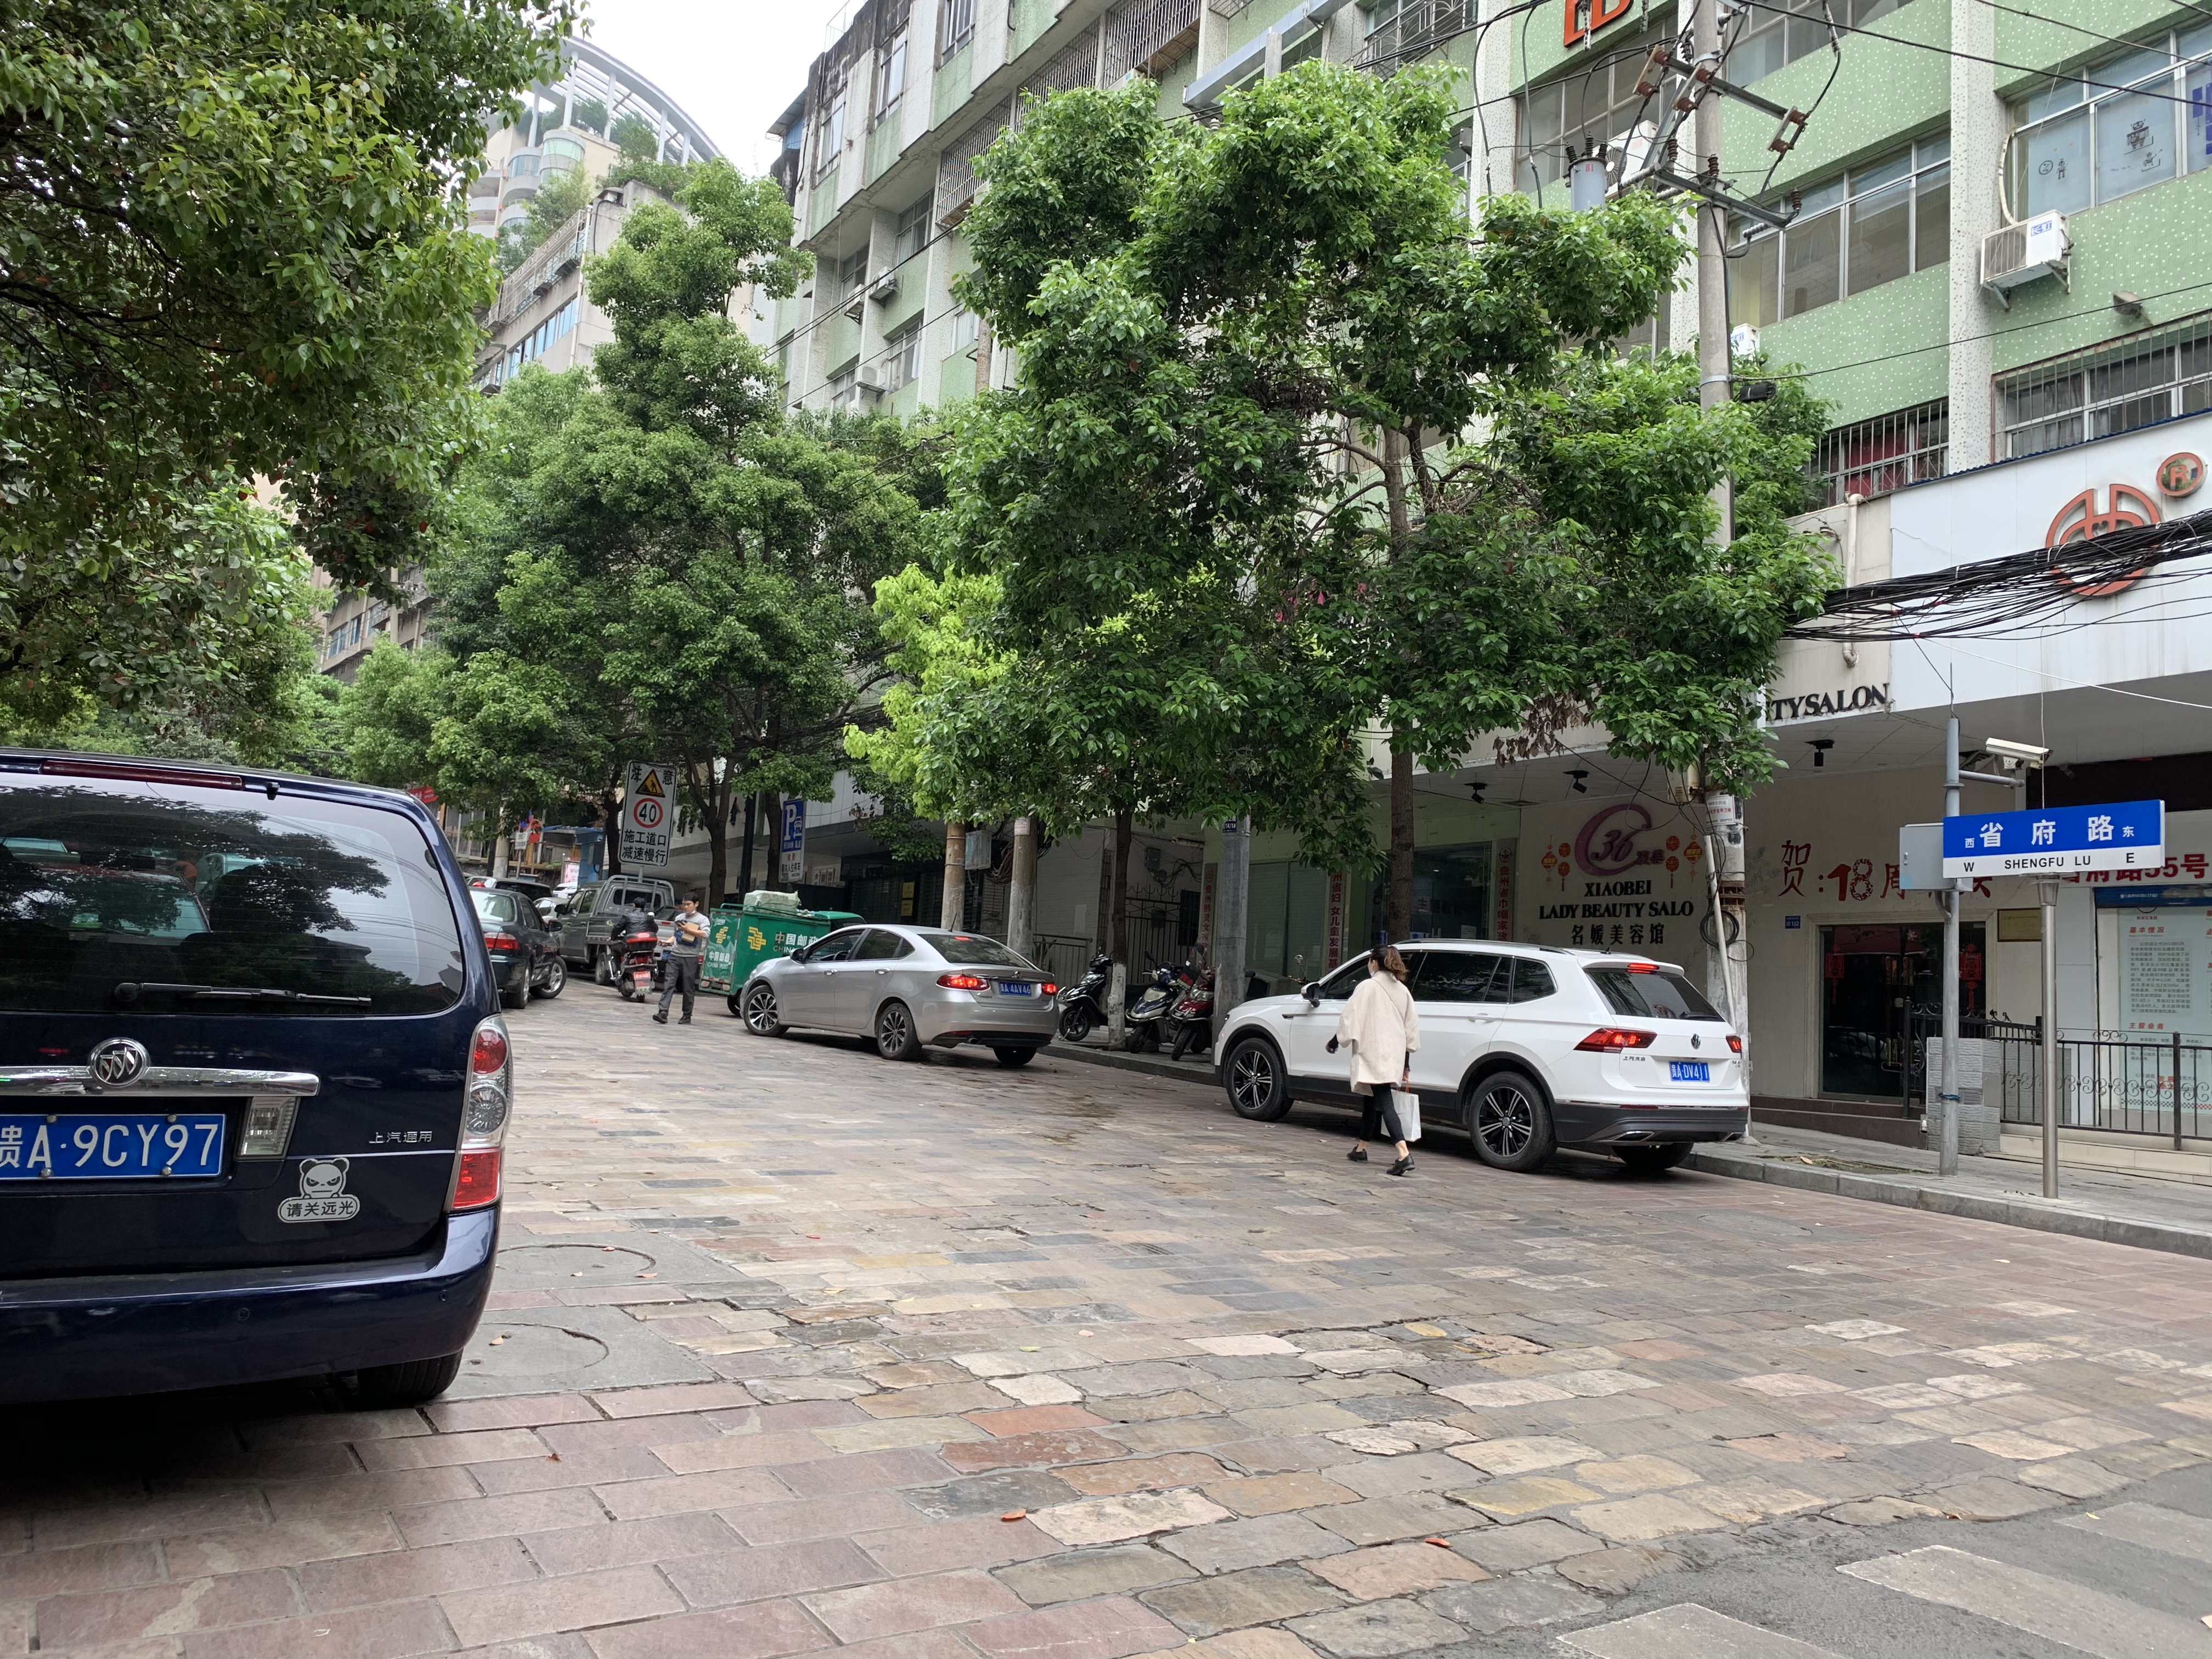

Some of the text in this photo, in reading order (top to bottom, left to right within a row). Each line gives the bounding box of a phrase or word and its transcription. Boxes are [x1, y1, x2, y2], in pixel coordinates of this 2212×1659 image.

[639, 803, 657, 823] 40
[784, 804, 797, 840] P
[624, 829, 667, 847] 施工道口
[1965, 815, 2135, 848] 西 省府路 东
[622, 845, 665, 864] 减速慢行
[1964, 853, 2135, 872] W SHENGFU LU E
[1584, 880, 1651, 897] XIAOBEI
[1539, 901, 1694, 919] LADY BEAUTY SALO
[1571, 923, 1664, 945] 名媛美容馆
[709, 951, 730, 963] 中国邮政
[369, 1130, 433, 1144] 上汽通用
[286, 1200, 354, 1218] 请关远光
